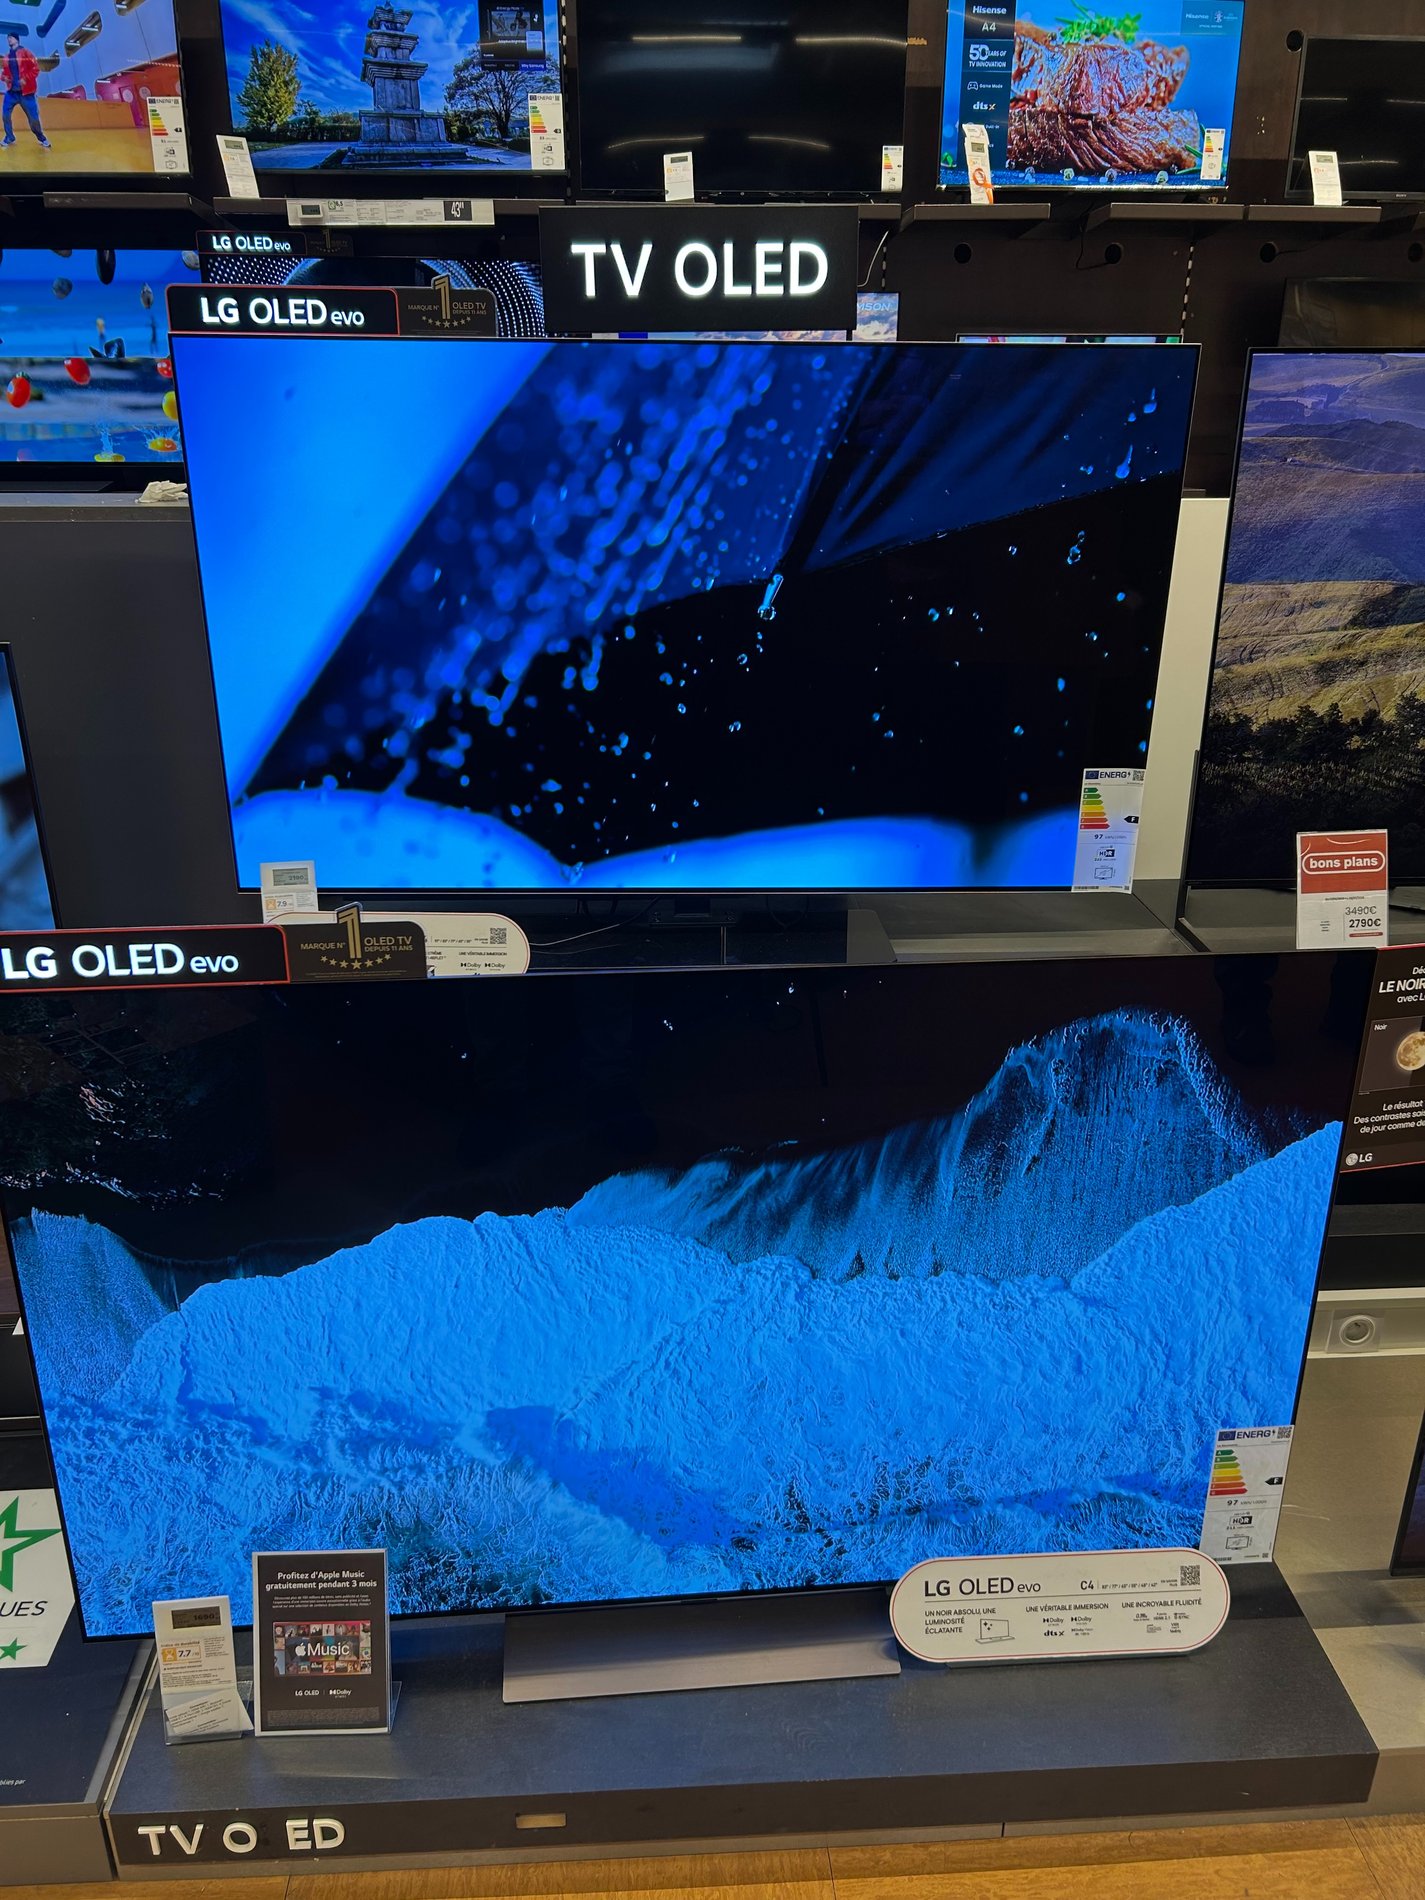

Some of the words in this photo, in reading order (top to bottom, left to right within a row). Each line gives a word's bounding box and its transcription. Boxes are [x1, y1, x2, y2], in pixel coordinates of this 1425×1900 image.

[973, 6, 1007, 14] Hisense
[982, 22, 996, 32] A4
[969, 44, 989, 61] 50
[450, 200, 465, 218] 43"
[211, 235, 231, 250] LG
[235, 236, 273, 250] OLED
[274, 242, 291, 251] evo
[570, 241, 653, 298] TV
[674, 241, 829, 298] OLED
[201, 297, 240, 324] LG
[249, 297, 328, 325] OLED
[330, 310, 365, 326] evo
[408, 303, 433, 311] MARQUE
[452, 302, 474, 310] OLED
[475, 302, 487, 310] TV
[1100, 771, 1127, 779] ENERG
[1309, 858, 1341, 869] bons
[1344, 856, 1378, 870] plans
[1345, 906, 1377, 916] 3490€
[1349, 918, 1382, 929] 2790€
[300, 942, 335, 951] MARQUE
[364, 936, 394, 947] OLED
[397, 936, 413, 946] TV
[398, 944, 414, 952] ANS
[1, 946, 59, 980] LG
[71, 943, 186, 978] OLED
[190, 954, 240, 974] evo
[1379, 980, 1396, 994] LE
[1396, 978, 1425, 992] NOIR
[1397, 994, 1419, 1003] avec
[1382, 1103, 1393, 1111] Le
[1393, 1100, 1424, 1110] résultat
[1353, 1116, 1370, 1125] Des
[1370, 1112, 1411, 1123] contrastes
[1360, 1125, 1371, 1134] de
[1370, 1124, 1387, 1134] jour
[1387, 1121, 1416, 1131] comme
[1359, 1153, 1373, 1163] LG
[1236, 1430, 1271, 1439] ENERG
[277, 1571, 309, 1580] Profitez
[310, 1571, 340, 1580] d'Apple
[342, 1570, 365, 1579] Music
[265, 1581, 316, 1592] gratuitement
[318, 1580, 350, 1590] pendant
[924, 1580, 950, 1597] LG
[959, 1577, 1015, 1596] OLED
[1017, 1582, 1041, 1593] evo
[1080, 1580, 1095, 1591] C4
[1040, 1604, 1072, 1612] VÉRITABLE
[1135, 1600, 1174, 1608] INCROYABLE
[1175, 1597, 1202, 1606] FLUIDITÉ
[0, 1600, 48, 1617] UES
[953, 1608, 982, 1616] ABSOLU,
[925, 1618, 965, 1626] LUMINOSITÉ
[925, 1627, 963, 1635] ÉCLATANTE
[178, 1649, 191, 1658] 7.7
[307, 1643, 350, 1657] Music
[138, 1823, 204, 1856] TV
